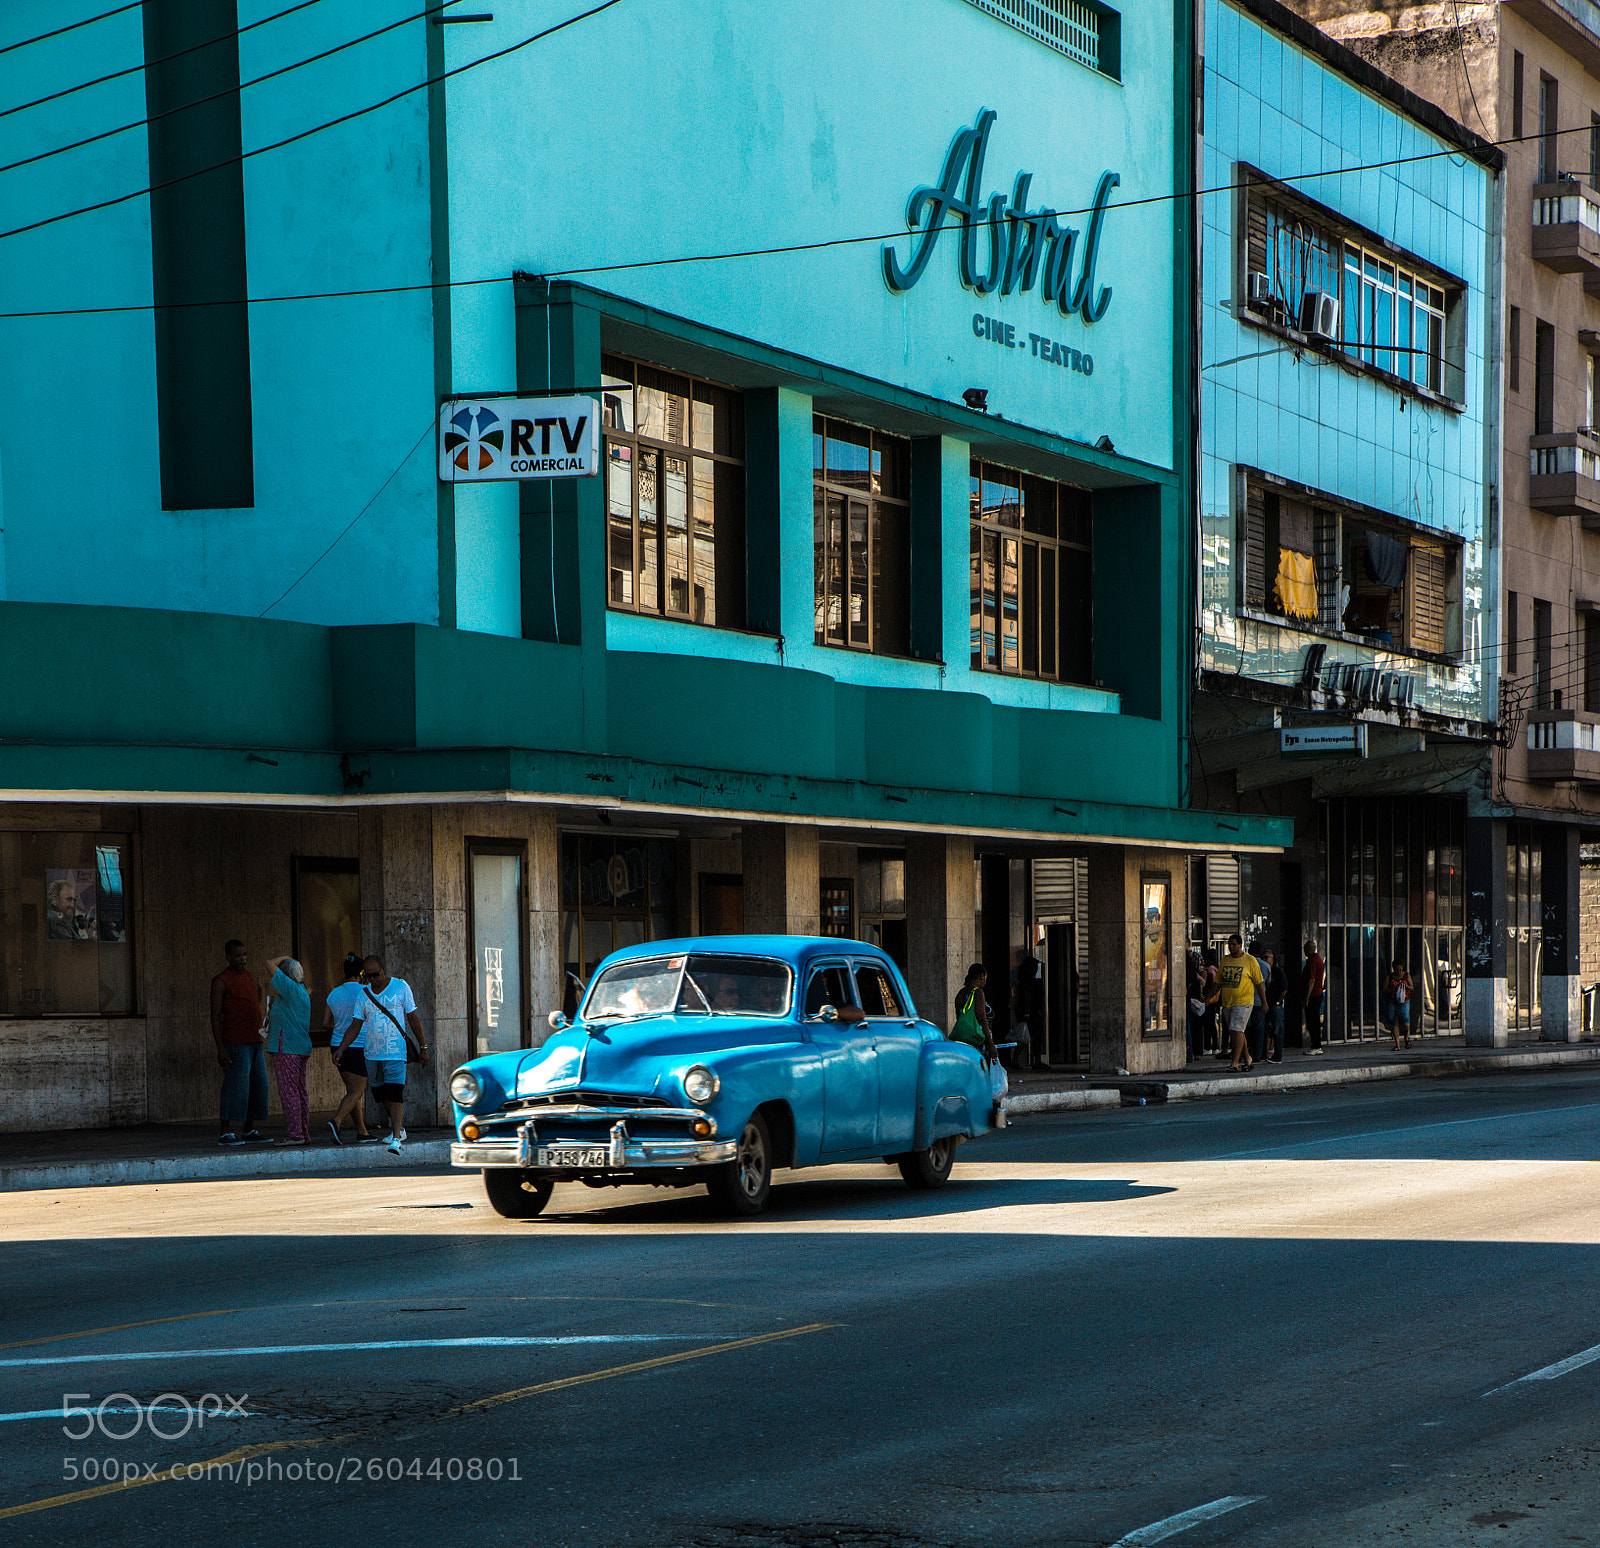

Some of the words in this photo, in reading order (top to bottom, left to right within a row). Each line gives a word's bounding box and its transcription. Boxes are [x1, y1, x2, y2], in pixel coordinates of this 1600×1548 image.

[881, 106, 1120, 327] Astral
[972, 313, 1016, 349] CINE
[1029, 333, 1094, 376] TEATRO
[510, 416, 588, 457] RTV
[510, 458, 585, 473] COMERCIAL
